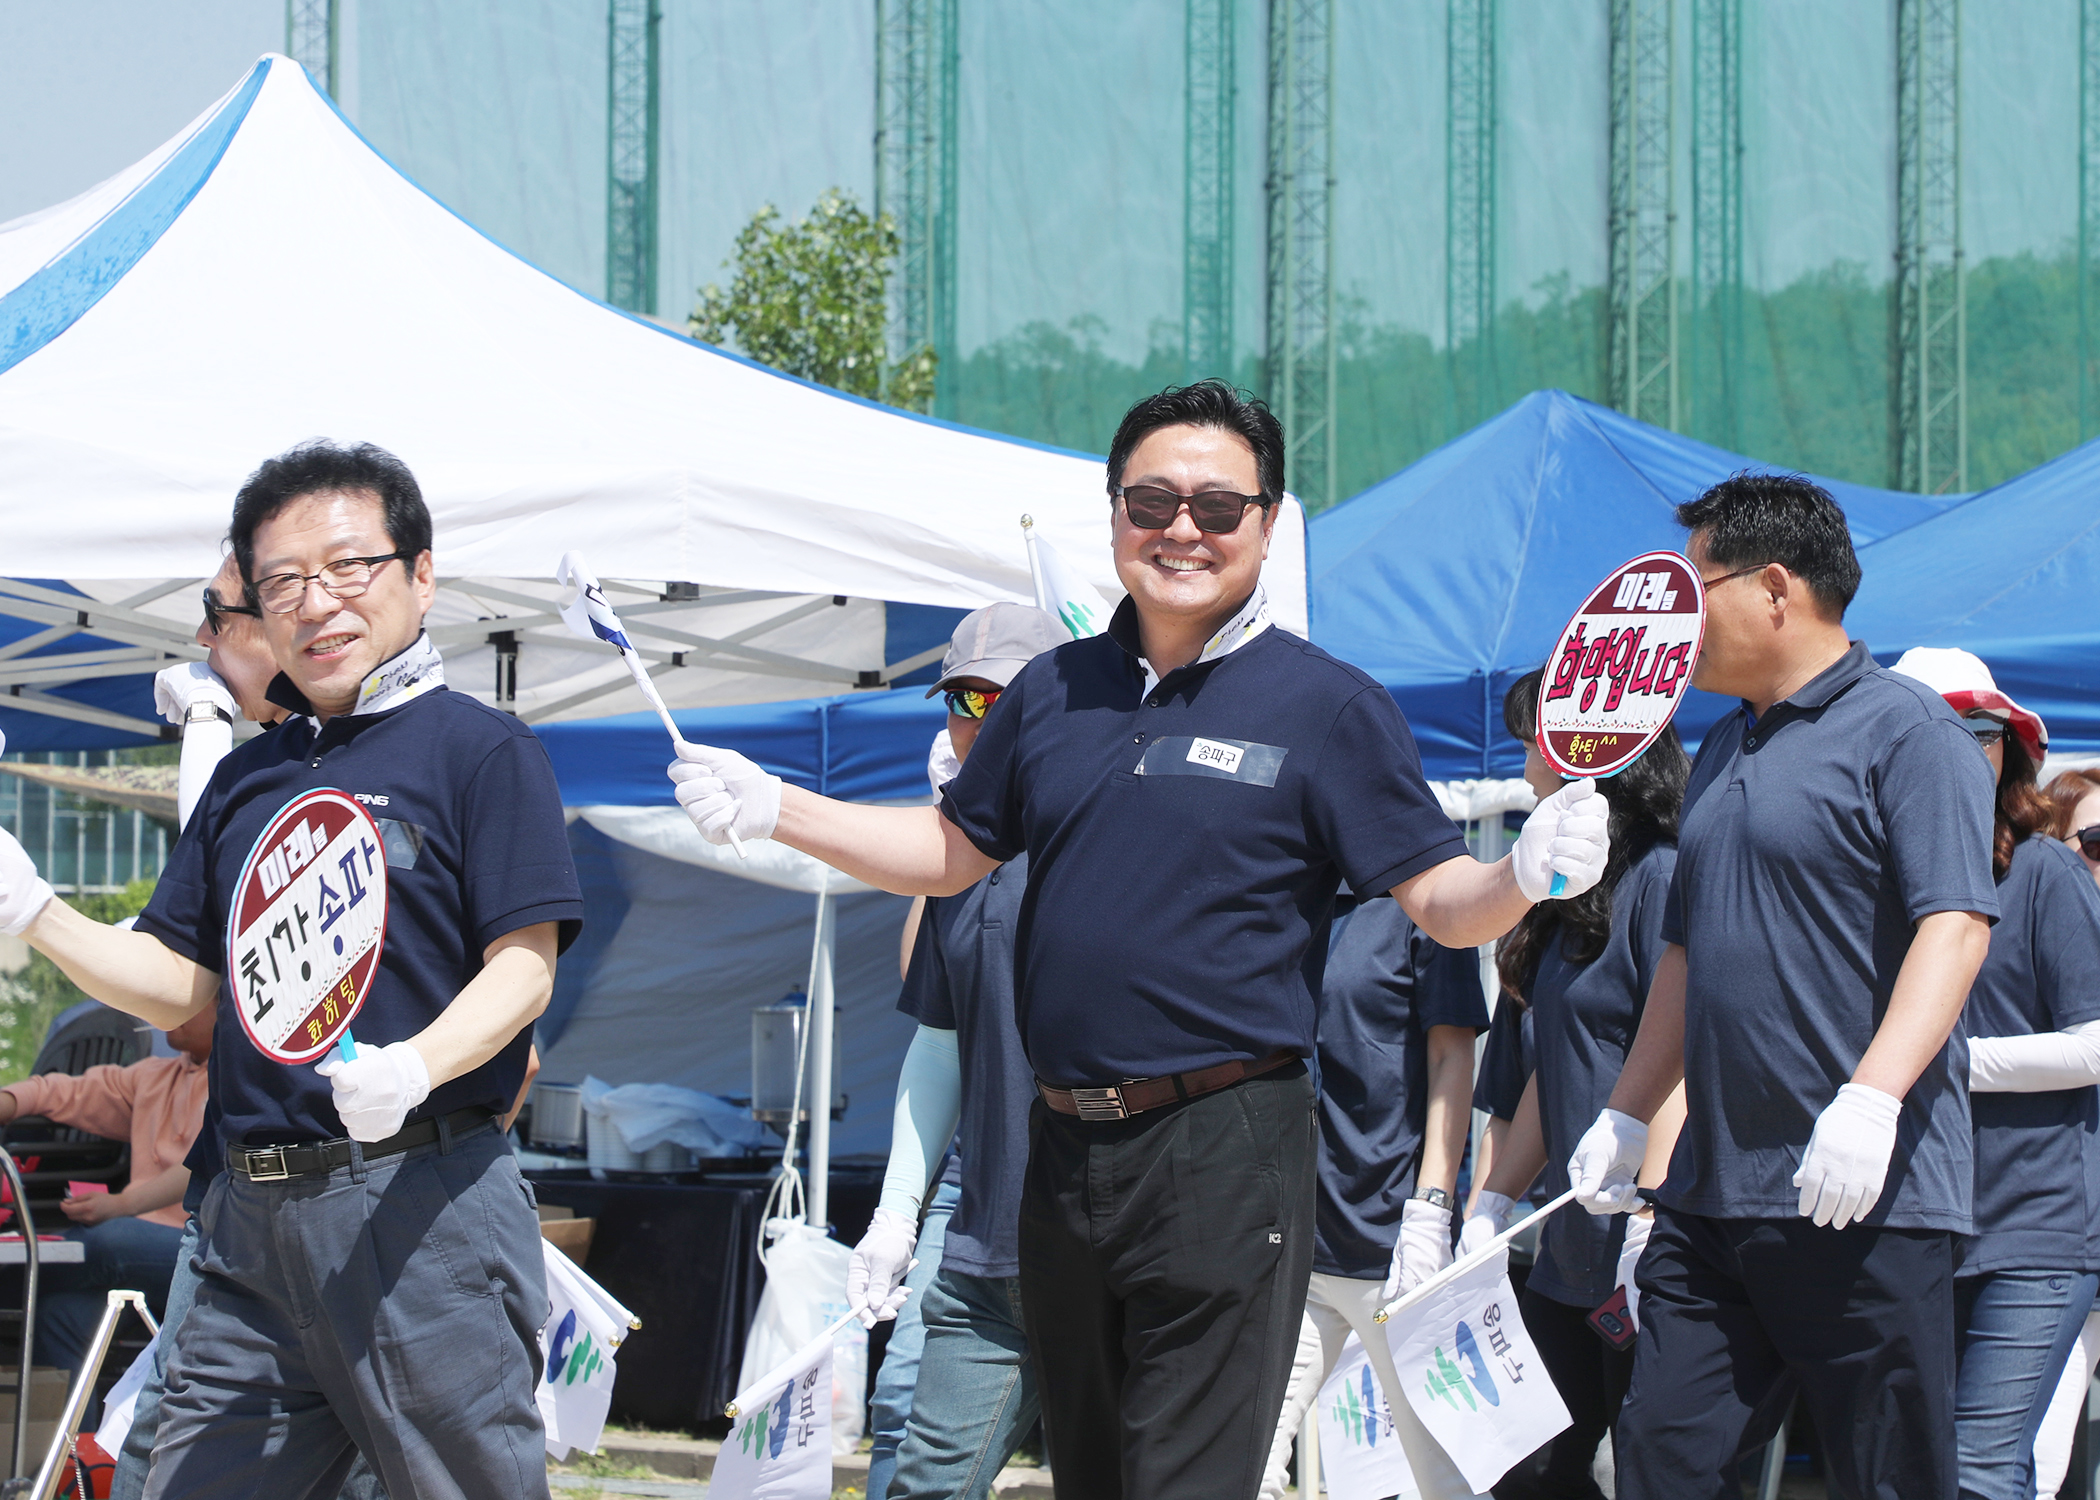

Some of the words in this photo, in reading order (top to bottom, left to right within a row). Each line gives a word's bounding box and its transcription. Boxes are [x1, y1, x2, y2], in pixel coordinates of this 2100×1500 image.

[1613, 572, 1678, 611] 미래팀
[1545, 622, 1692, 713] 희망입니다
[1198, 745, 1236, 766] 송파구
[354, 793, 389, 806] PING
[257, 817, 328, 900] 미래팀
